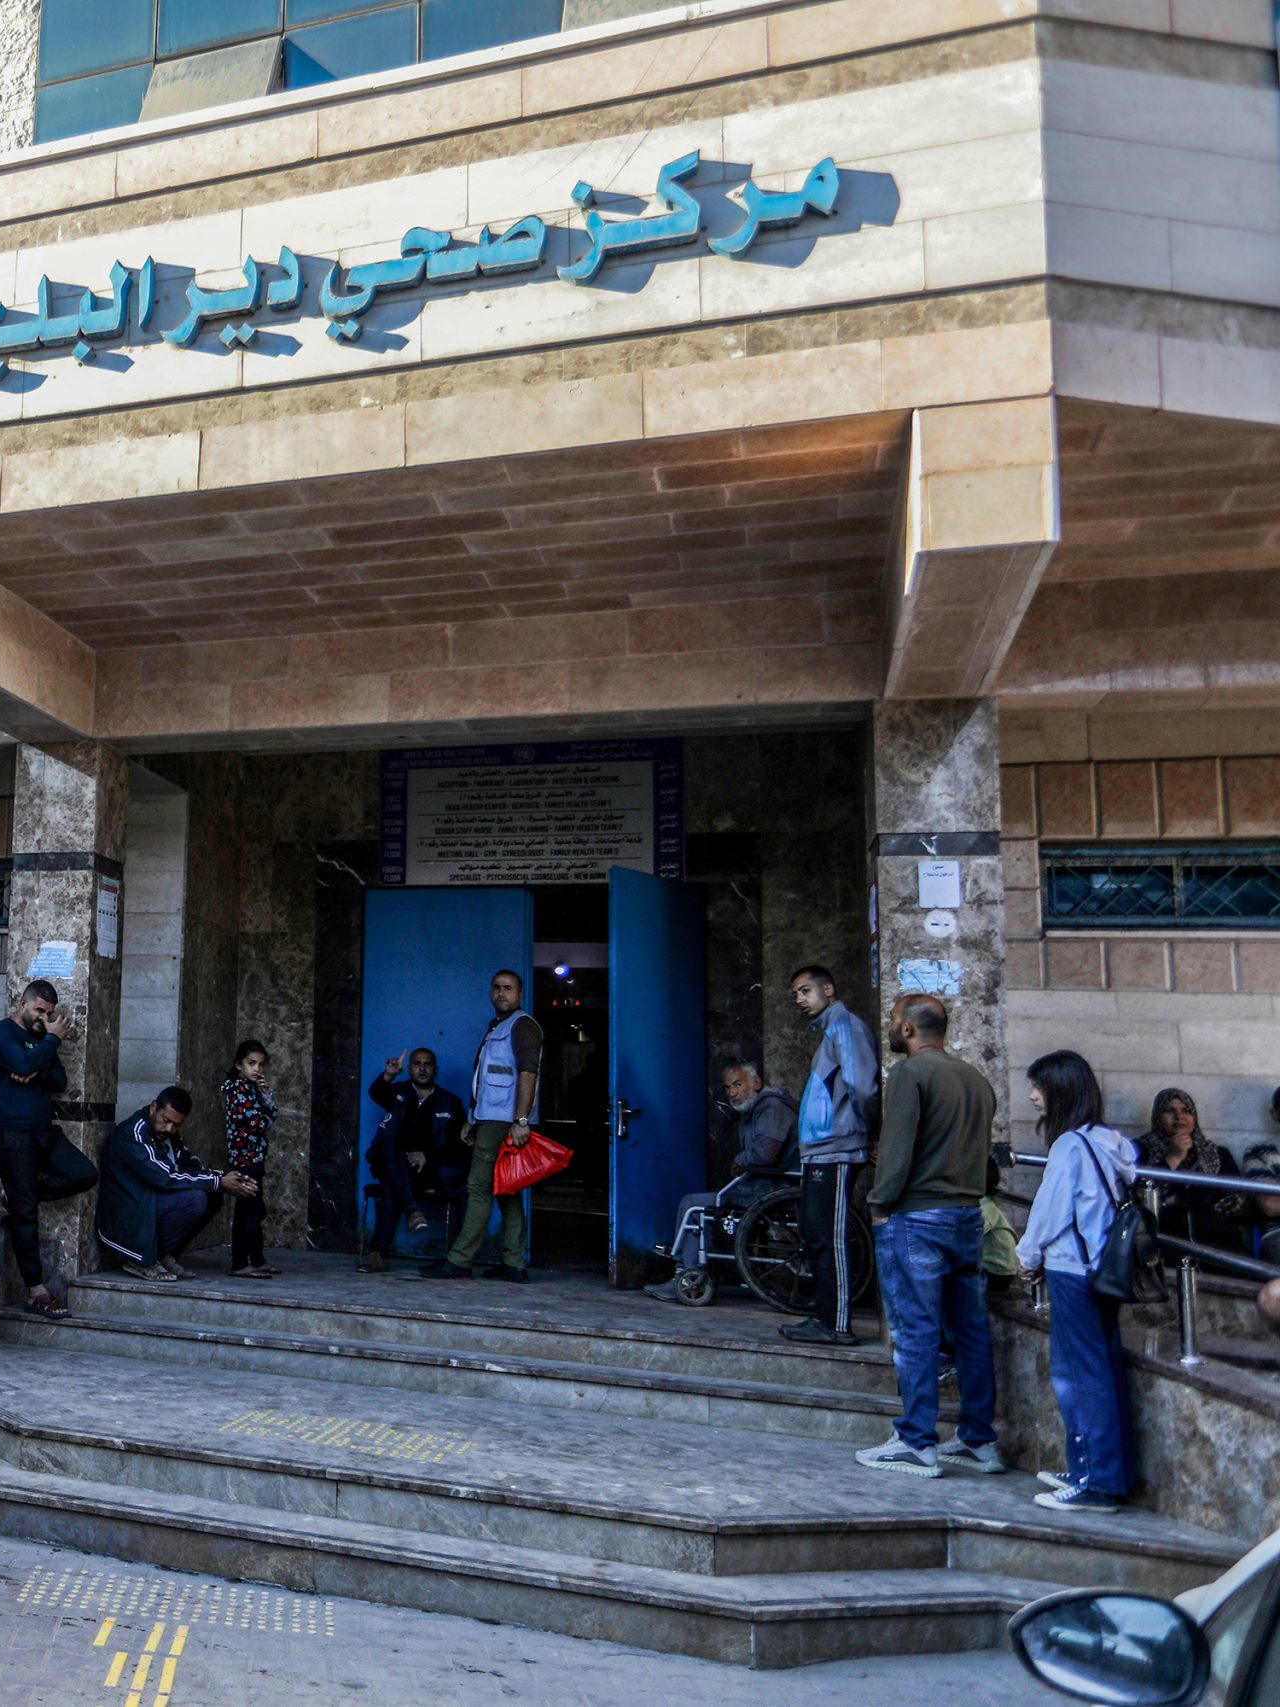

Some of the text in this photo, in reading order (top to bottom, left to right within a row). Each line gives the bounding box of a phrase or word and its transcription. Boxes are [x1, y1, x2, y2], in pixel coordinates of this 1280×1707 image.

[556, 149, 840, 286] مركز
[321, 214, 547, 343] صحي
[160, 244, 303, 349] دير
[473, 778, 504, 787] PHARMACY
[510, 777, 545, 786] LABORATORY
[589, 775, 620, 783] DRESSING
[461, 803, 483, 811] HEALTH
[484, 802, 506, 810] CENTER
[511, 801, 539, 809] DENTISTS
[543, 800, 564, 808] FAMILY
[565, 800, 588, 808] HEALTH
[589, 799, 607, 807] TEAM
[455, 826, 472, 834] STAFF
[497, 825, 518, 833] FAMILY
[519, 825, 548, 833] PLANNING
[553, 824, 574, 832] FAMILY
[575, 823, 598, 832] HEALTH
[599, 823, 617, 831] TEAM
[437, 850, 462, 858] MEETING
[483, 849, 497, 857] GYM
[501, 848, 544, 857] GYNECOLOGIST
[550, 848, 570, 856] FAMILY
[571, 847, 594, 856] HEALTH
[595, 847, 612, 855] TEAM
[448, 873, 481, 881] SPECIALIST
[486, 872, 528, 881] PSYCHOSOCIAL
[530, 872, 569, 881] COUNSELORS
[573, 872, 590, 880] NEW
